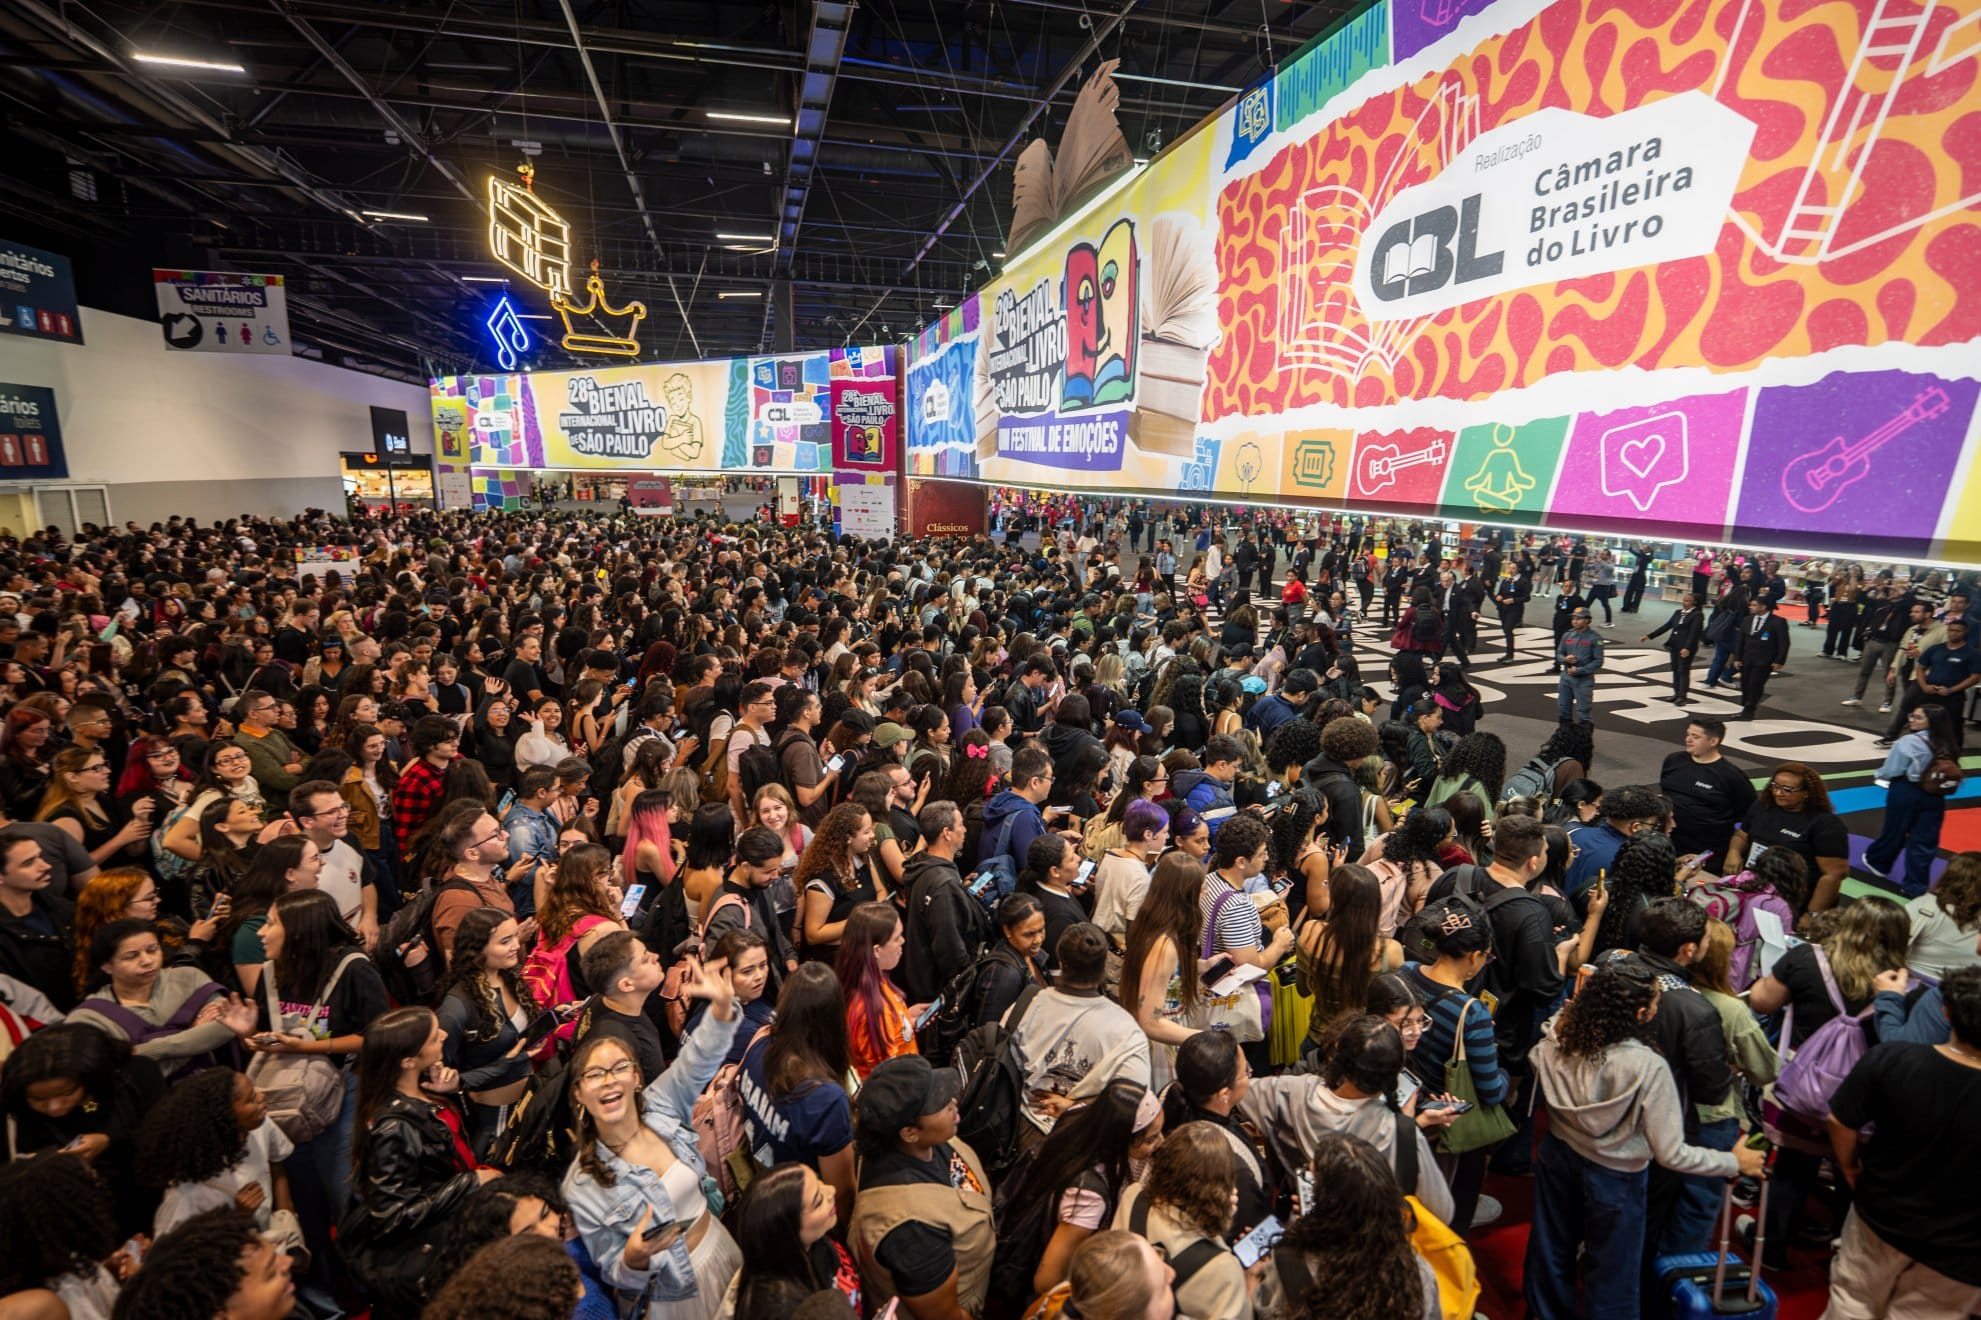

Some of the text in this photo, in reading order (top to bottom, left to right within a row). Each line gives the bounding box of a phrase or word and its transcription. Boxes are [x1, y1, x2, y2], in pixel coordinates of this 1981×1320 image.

[1475, 133, 1543, 173] Realização
[1534, 137, 1663, 197] Câmara
[1528, 165, 1694, 234] Brasileira
[1370, 193, 1505, 302] CBL
[1526, 211, 1664, 268] do Livro
[183, 287, 263, 306] SANITÁRIOS
[1008, 281, 1054, 348] BIENAL
[1028, 318, 1067, 373] LIVRO
[588, 383, 649, 415] BIENAL
[1000, 372, 1018, 408] SÃO
[1018, 372, 1051, 407] PAULO
[577, 428, 604, 453] SÃO
[605, 434, 649, 456] PAULO
[619, 407, 666, 434] LIVRO
[1010, 425, 1047, 452] FESTIVAL
[1048, 425, 1062, 453] DE
[1062, 414, 1119, 462] EMOÇÕES
[926, 522, 969, 532] Clássicos
[736, 1068, 791, 1143] RAHAM
